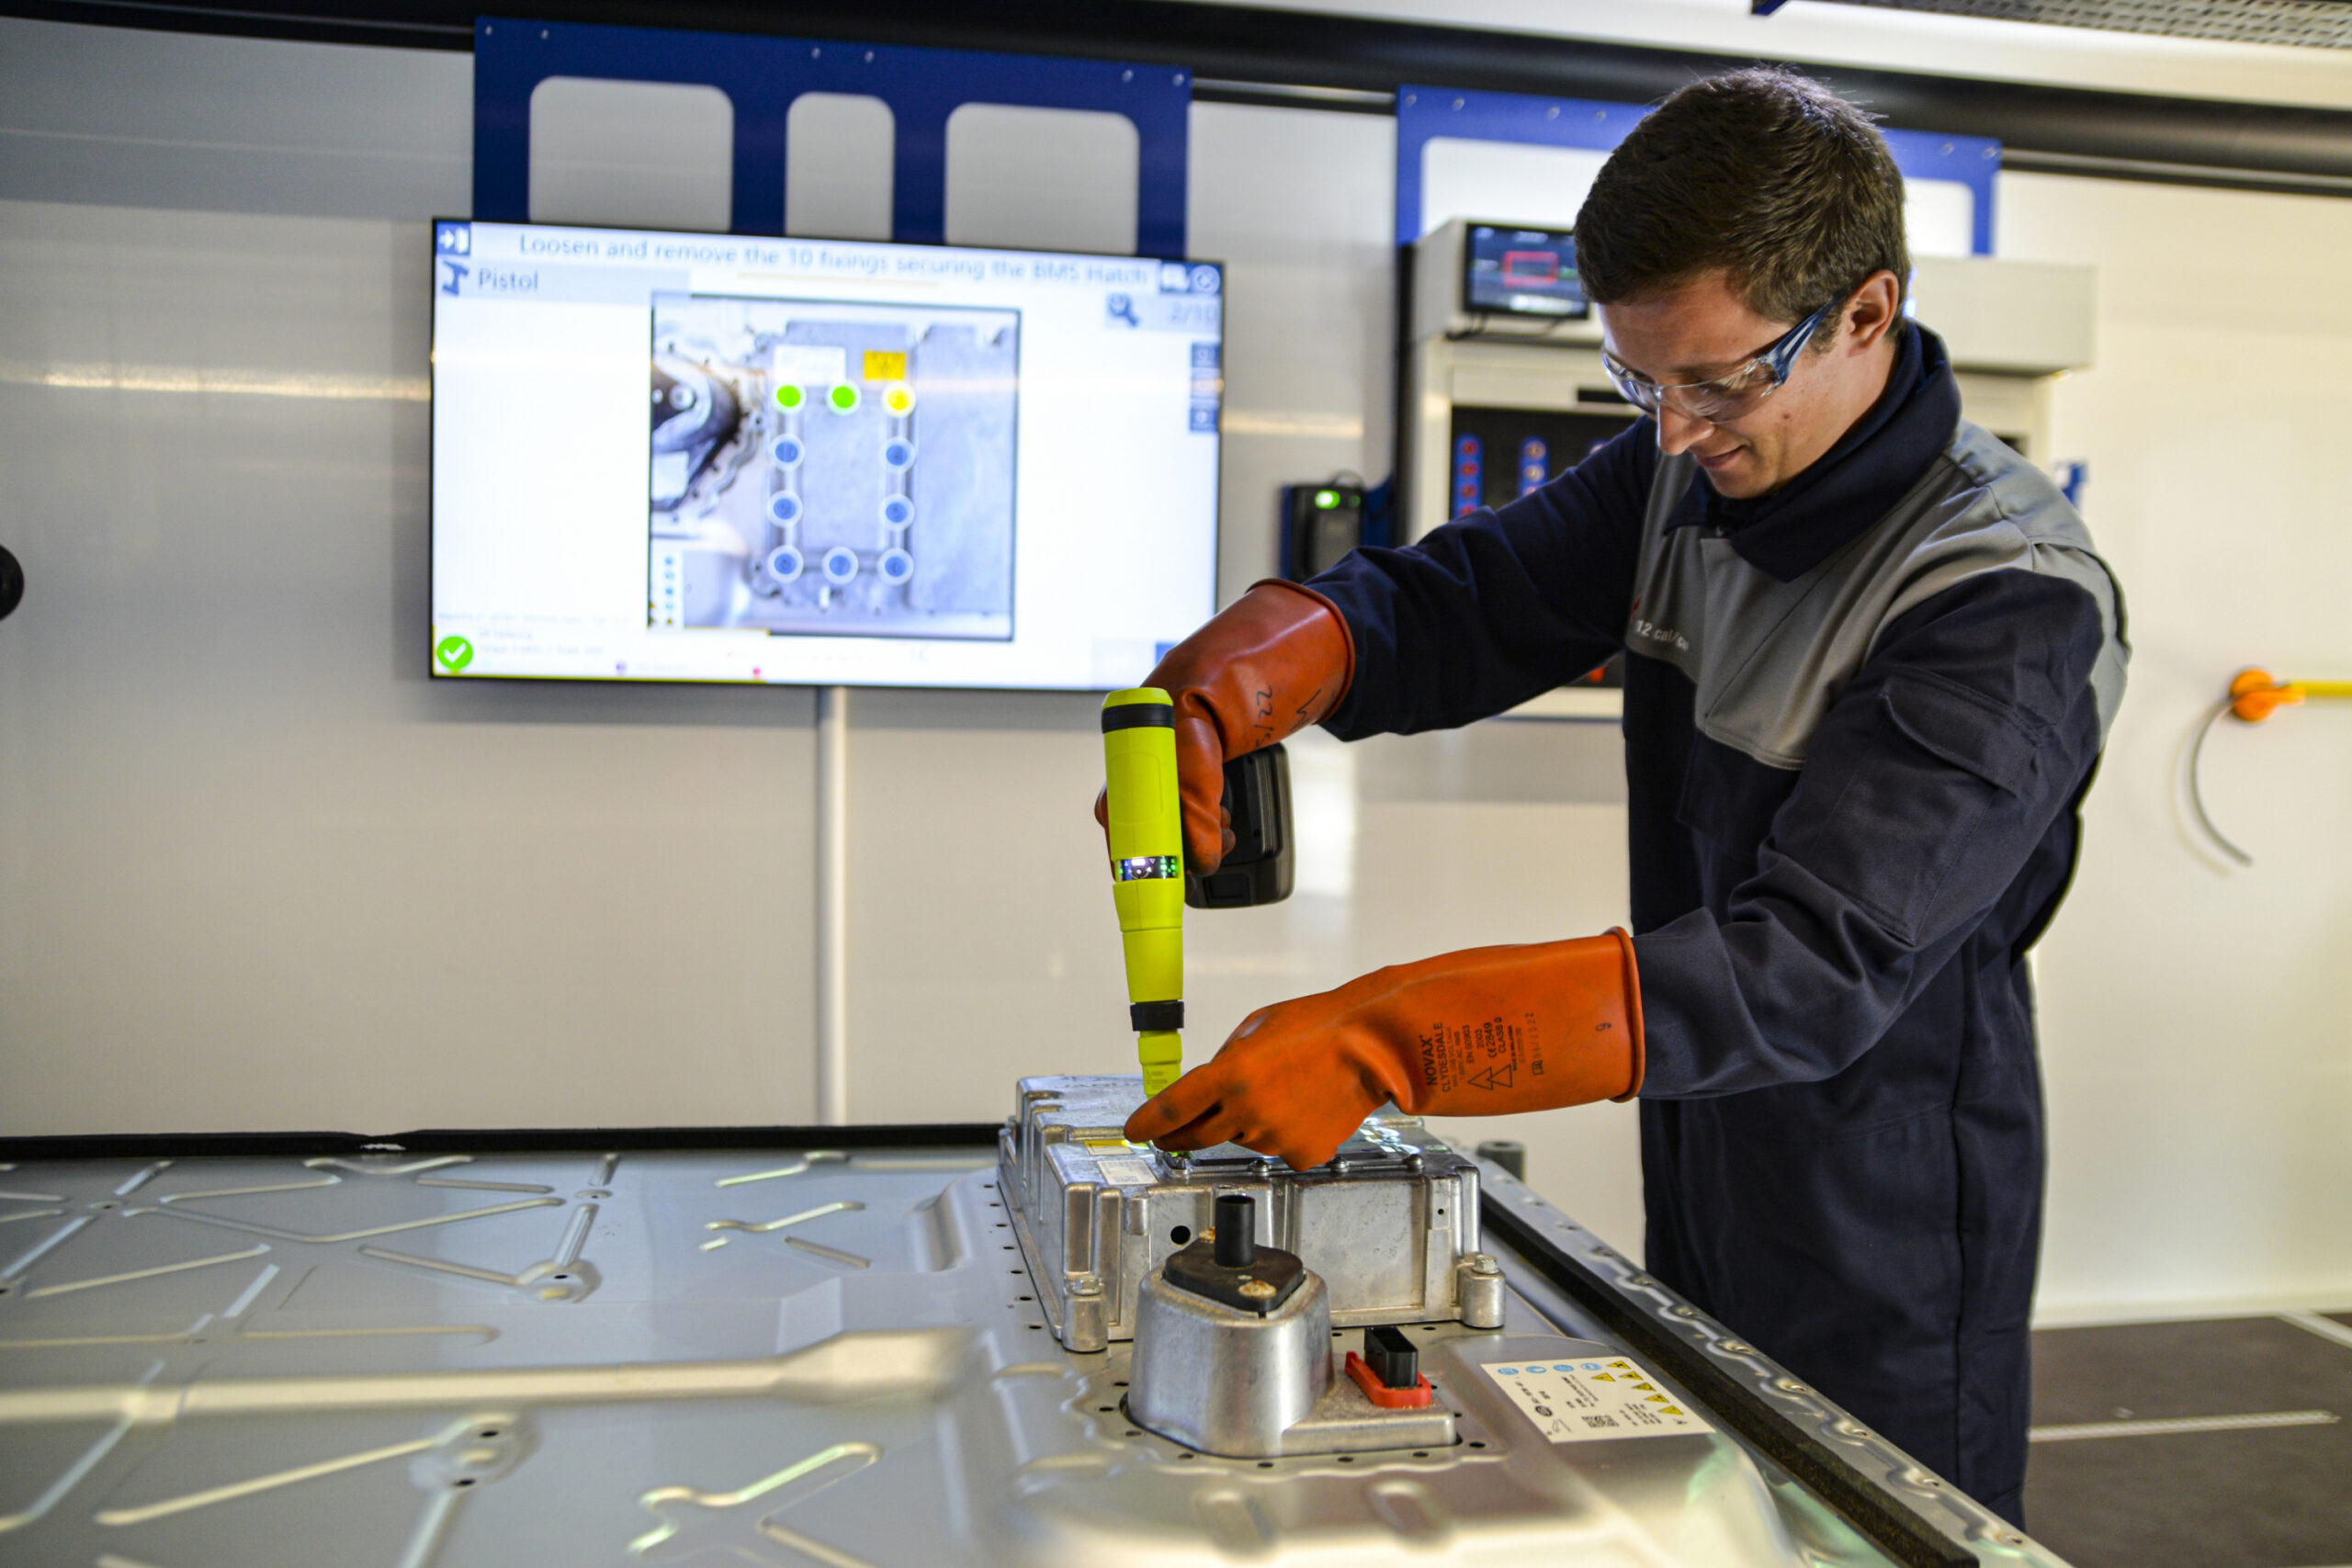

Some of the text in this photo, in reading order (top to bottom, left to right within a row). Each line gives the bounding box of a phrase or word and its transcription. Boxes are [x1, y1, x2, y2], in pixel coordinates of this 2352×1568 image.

[519, 232, 1148, 287] Loosen and remove the 10 fixings securing the BMS Hatch
[478, 267, 539, 292] Pistol
[1635, 619, 1653, 637] 12
[1474, 1028, 1485, 1049] 2003
[1495, 1024, 1507, 1054] CLASS
[1433, 1021, 1452, 1093] CLYDESDALE
[1465, 1051, 1475, 1064] EN
